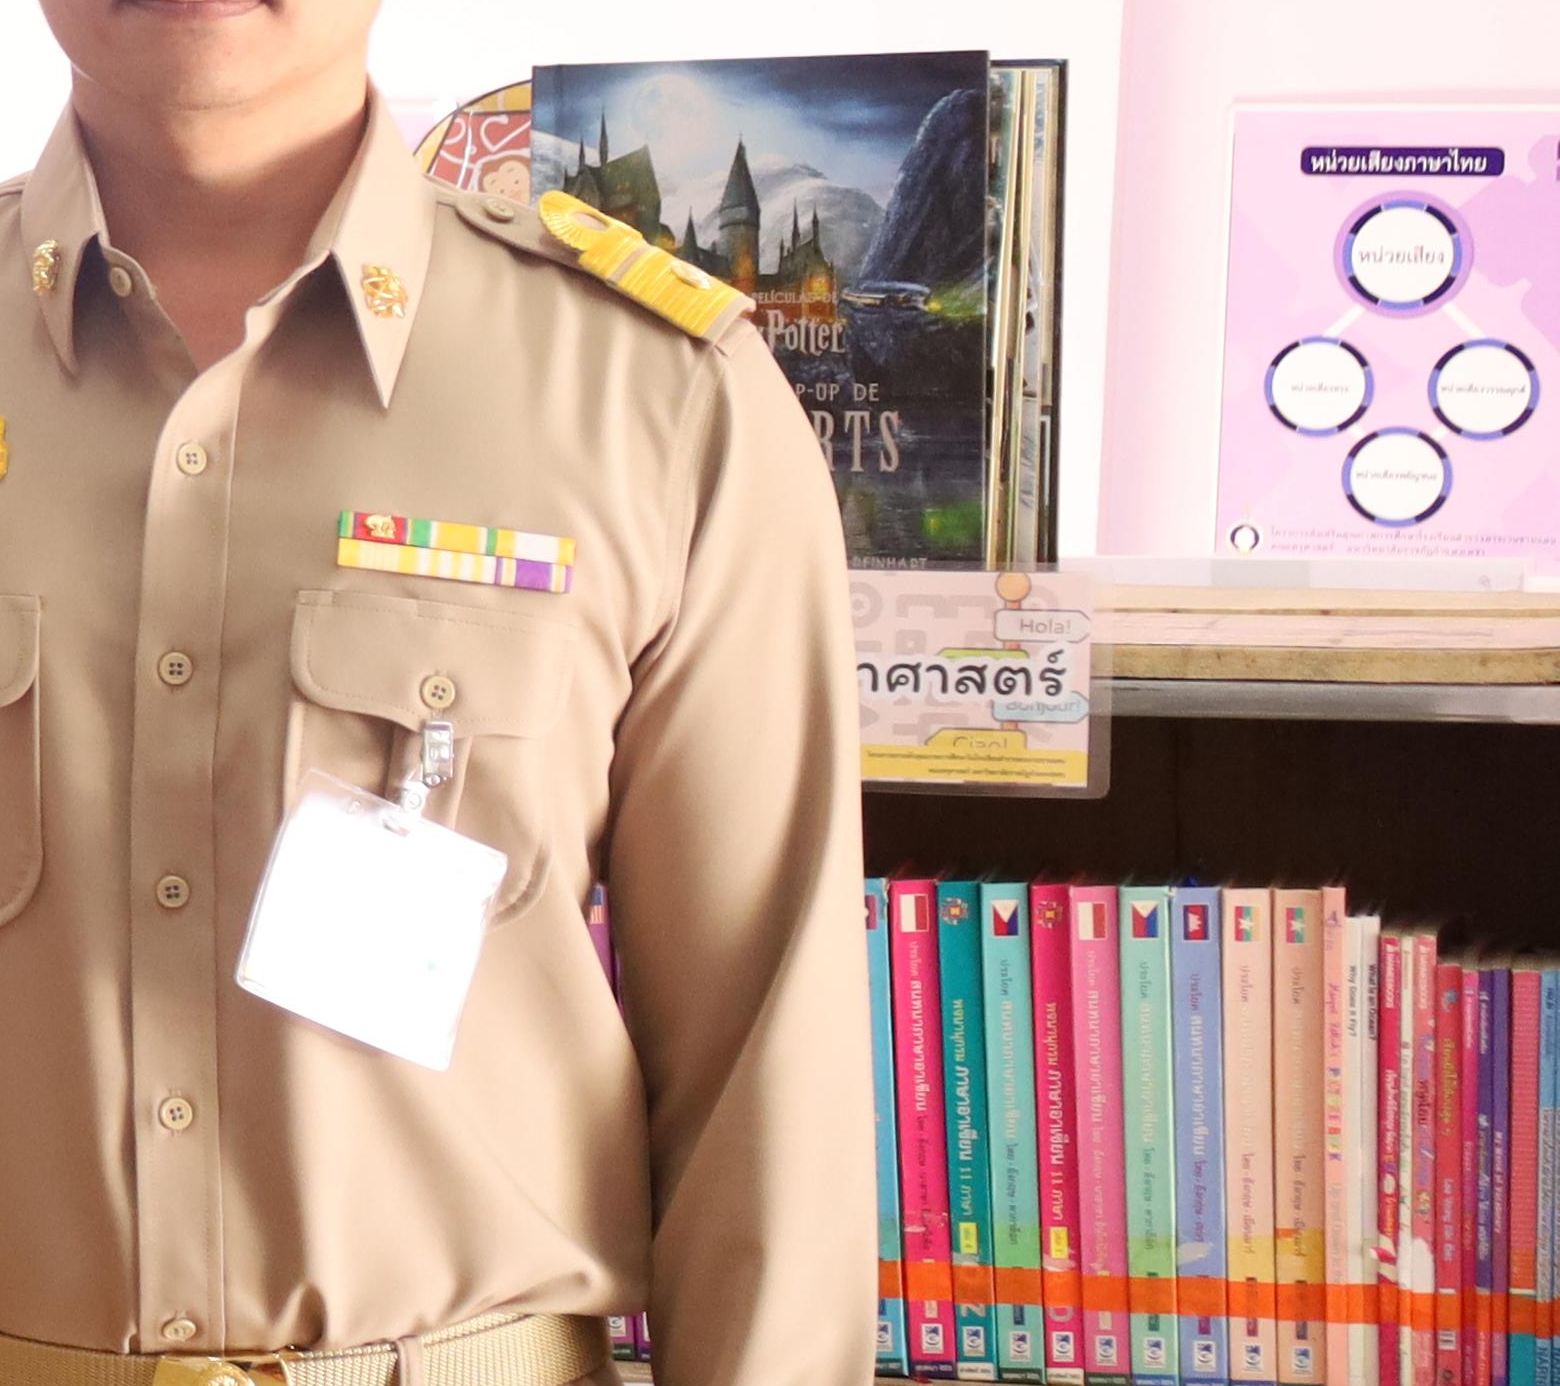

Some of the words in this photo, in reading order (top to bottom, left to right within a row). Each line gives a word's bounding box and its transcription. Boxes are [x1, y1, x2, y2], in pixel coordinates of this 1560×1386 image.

[1310, 148, 1486, 174] หน่วยเสียงภาษาไทย
[1358, 246, 1445, 266] หน่วยเสียง
[853, 384, 879, 401] DE
[1019, 617, 1071, 634] Hola!
[1348, 966, 1358, 984] Why
[1368, 964, 1377, 988] What
[1347, 1019, 1358, 1037] Fly?
[911, 980, 930, 1111] สนทนาภาษาอาเซียน
[955, 1065, 974, 1160] ภาษาอาเซียน
[1047, 1068, 1066, 1164] ภาษาอาเซียน
[960, 1167, 972, 1180] 11
[1052, 1171, 1064, 1184] 11
[960, 1185, 974, 1215] ภาษา
[1052, 1189, 1066, 1220] ภาษา
